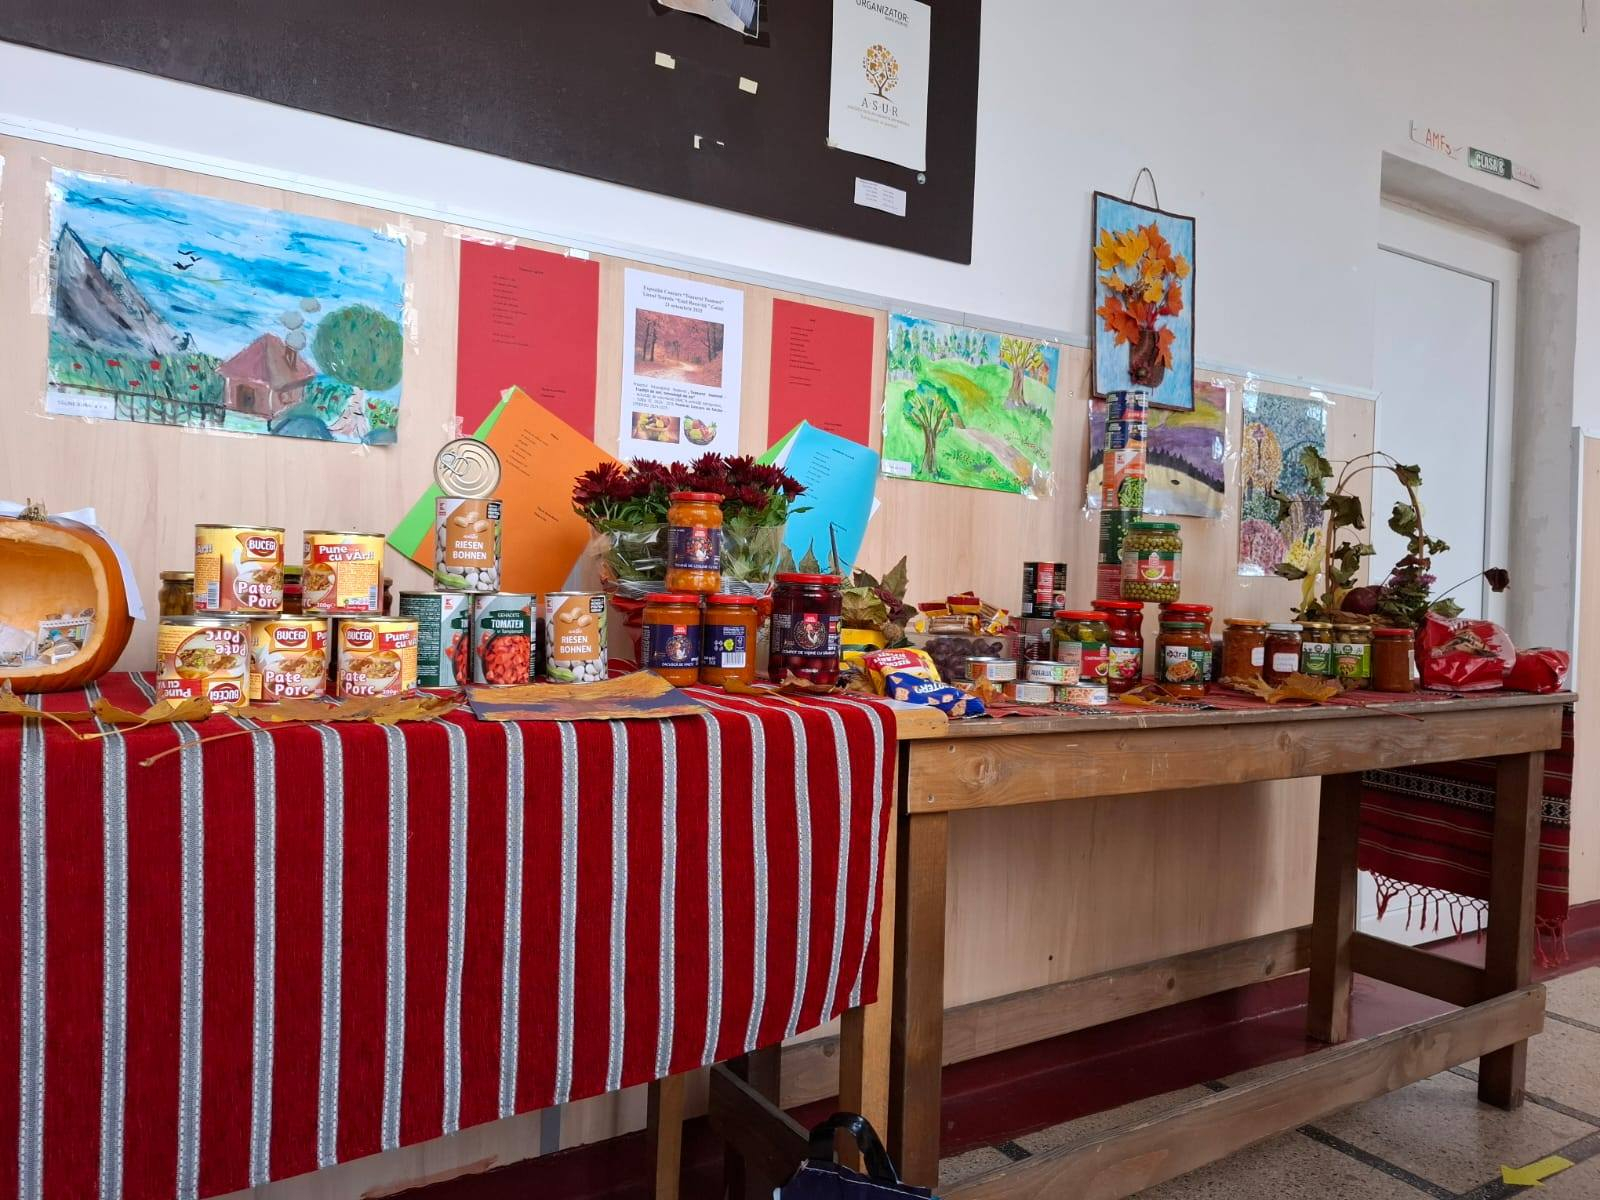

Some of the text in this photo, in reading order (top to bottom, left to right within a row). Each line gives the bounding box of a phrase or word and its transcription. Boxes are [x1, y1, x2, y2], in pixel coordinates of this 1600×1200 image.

[248, 540, 275, 550] BUCEGI
[455, 540, 484, 549] RIESEN
[320, 546, 348, 554] Pune
[452, 551, 487, 560] BOHNEN
[238, 581, 272, 594] Pate
[248, 595, 278, 607] Porc
[491, 620, 524, 628] TOMATEN
[206, 630, 240, 643] Porc
[276, 630, 306, 640] BUCEGI
[347, 631, 372, 640] BUCEGI
[385, 633, 409, 642] Pune
[561, 636, 588, 644] RIESEN
[216, 644, 246, 656] Pate
[560, 645, 592, 653] BOHNEN
[266, 671, 301, 682] Pate
[340, 670, 366, 682] Pate
[165, 688, 192, 697] Pune
[275, 684, 308, 696] Porc
[345, 682, 375, 694] Porc
[209, 690, 239, 700] BUCEGI
